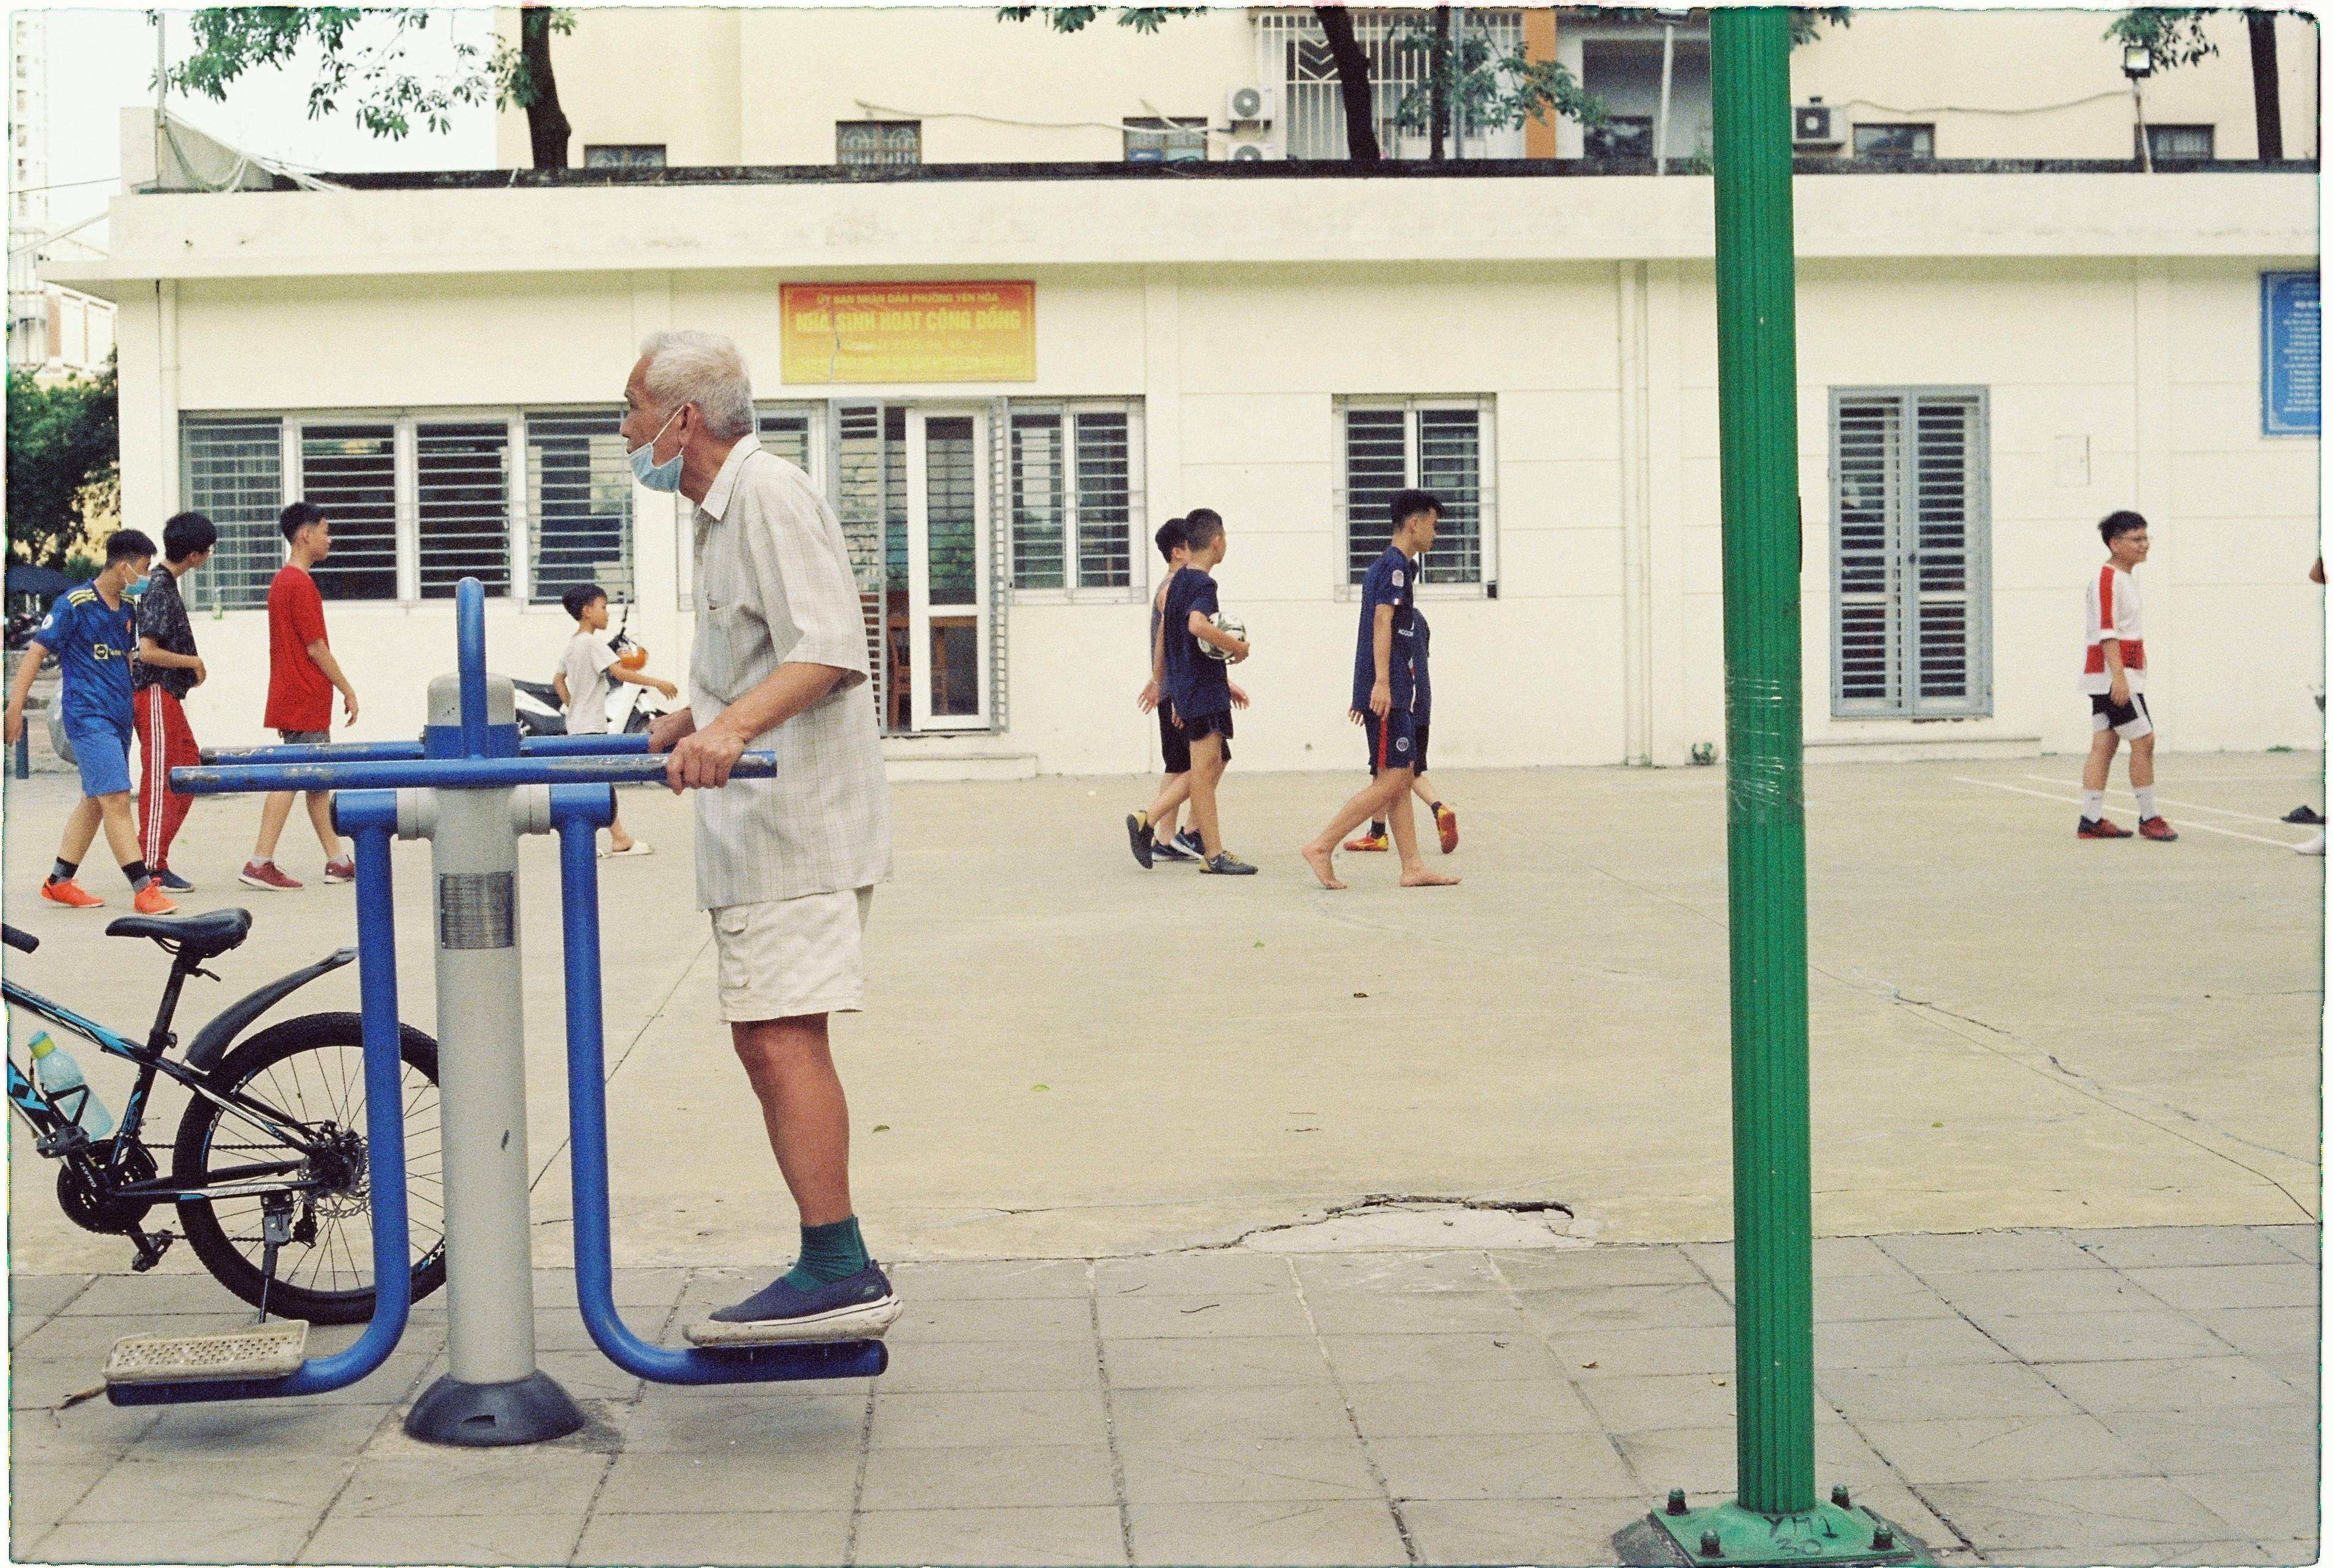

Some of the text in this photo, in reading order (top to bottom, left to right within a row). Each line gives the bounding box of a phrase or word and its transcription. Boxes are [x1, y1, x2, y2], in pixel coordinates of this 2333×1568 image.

[833, 294, 855, 304] BAN
[835, 311, 876, 332] SINH
[880, 310, 922, 334] HOẠT
[925, 306, 971, 335] CỘNG
[1776, 1538, 1824, 1557] 30
